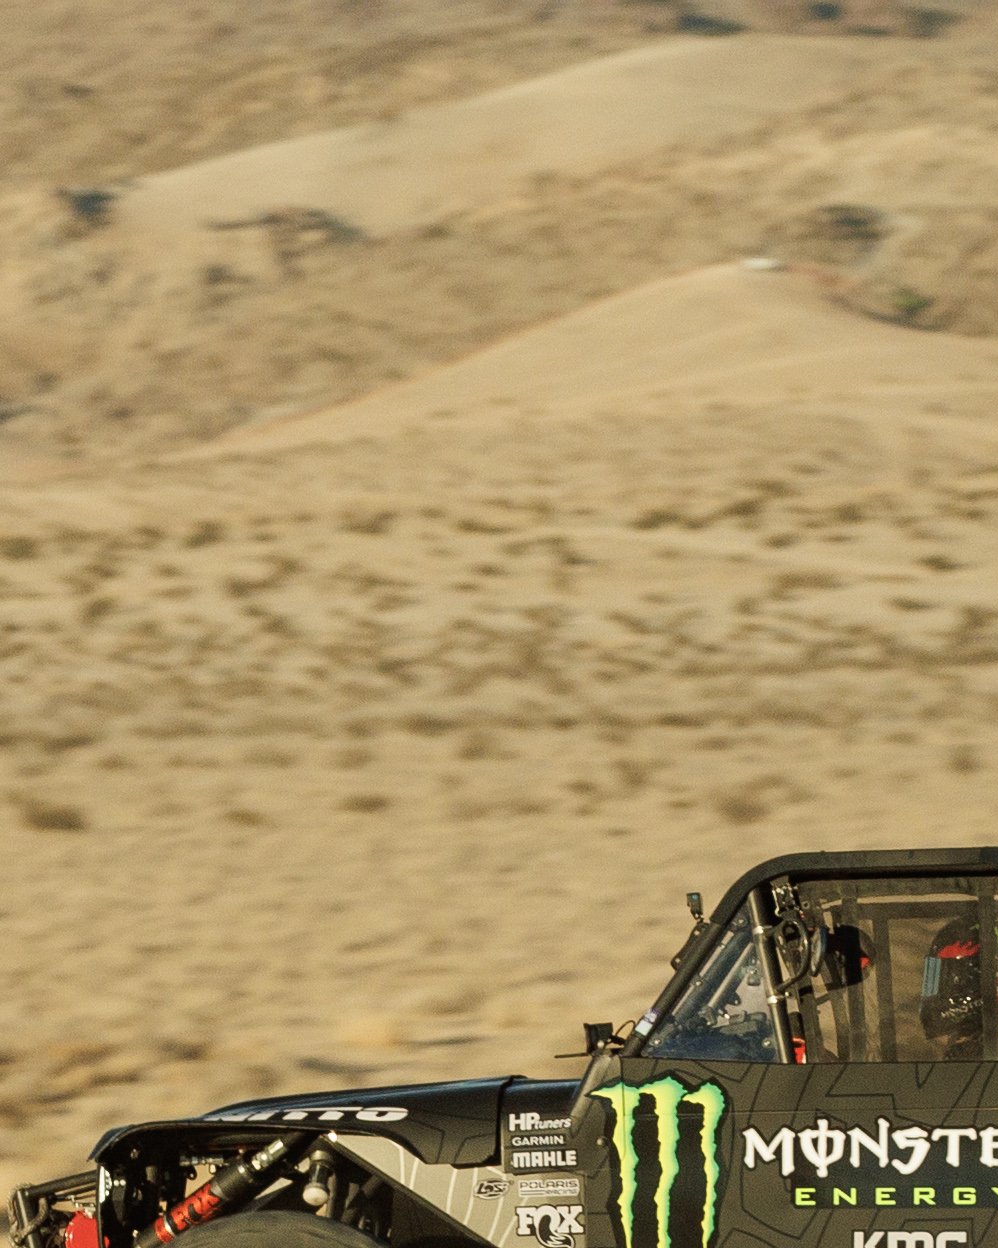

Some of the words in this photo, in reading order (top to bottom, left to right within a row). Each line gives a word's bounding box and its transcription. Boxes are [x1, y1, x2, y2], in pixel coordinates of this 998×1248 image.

[512, 1136, 564, 1146] GARMIN
[511, 1150, 577, 1168] MAHLE
[519, 1179, 578, 1189] POLARIS
[170, 1183, 221, 1231] FOX
